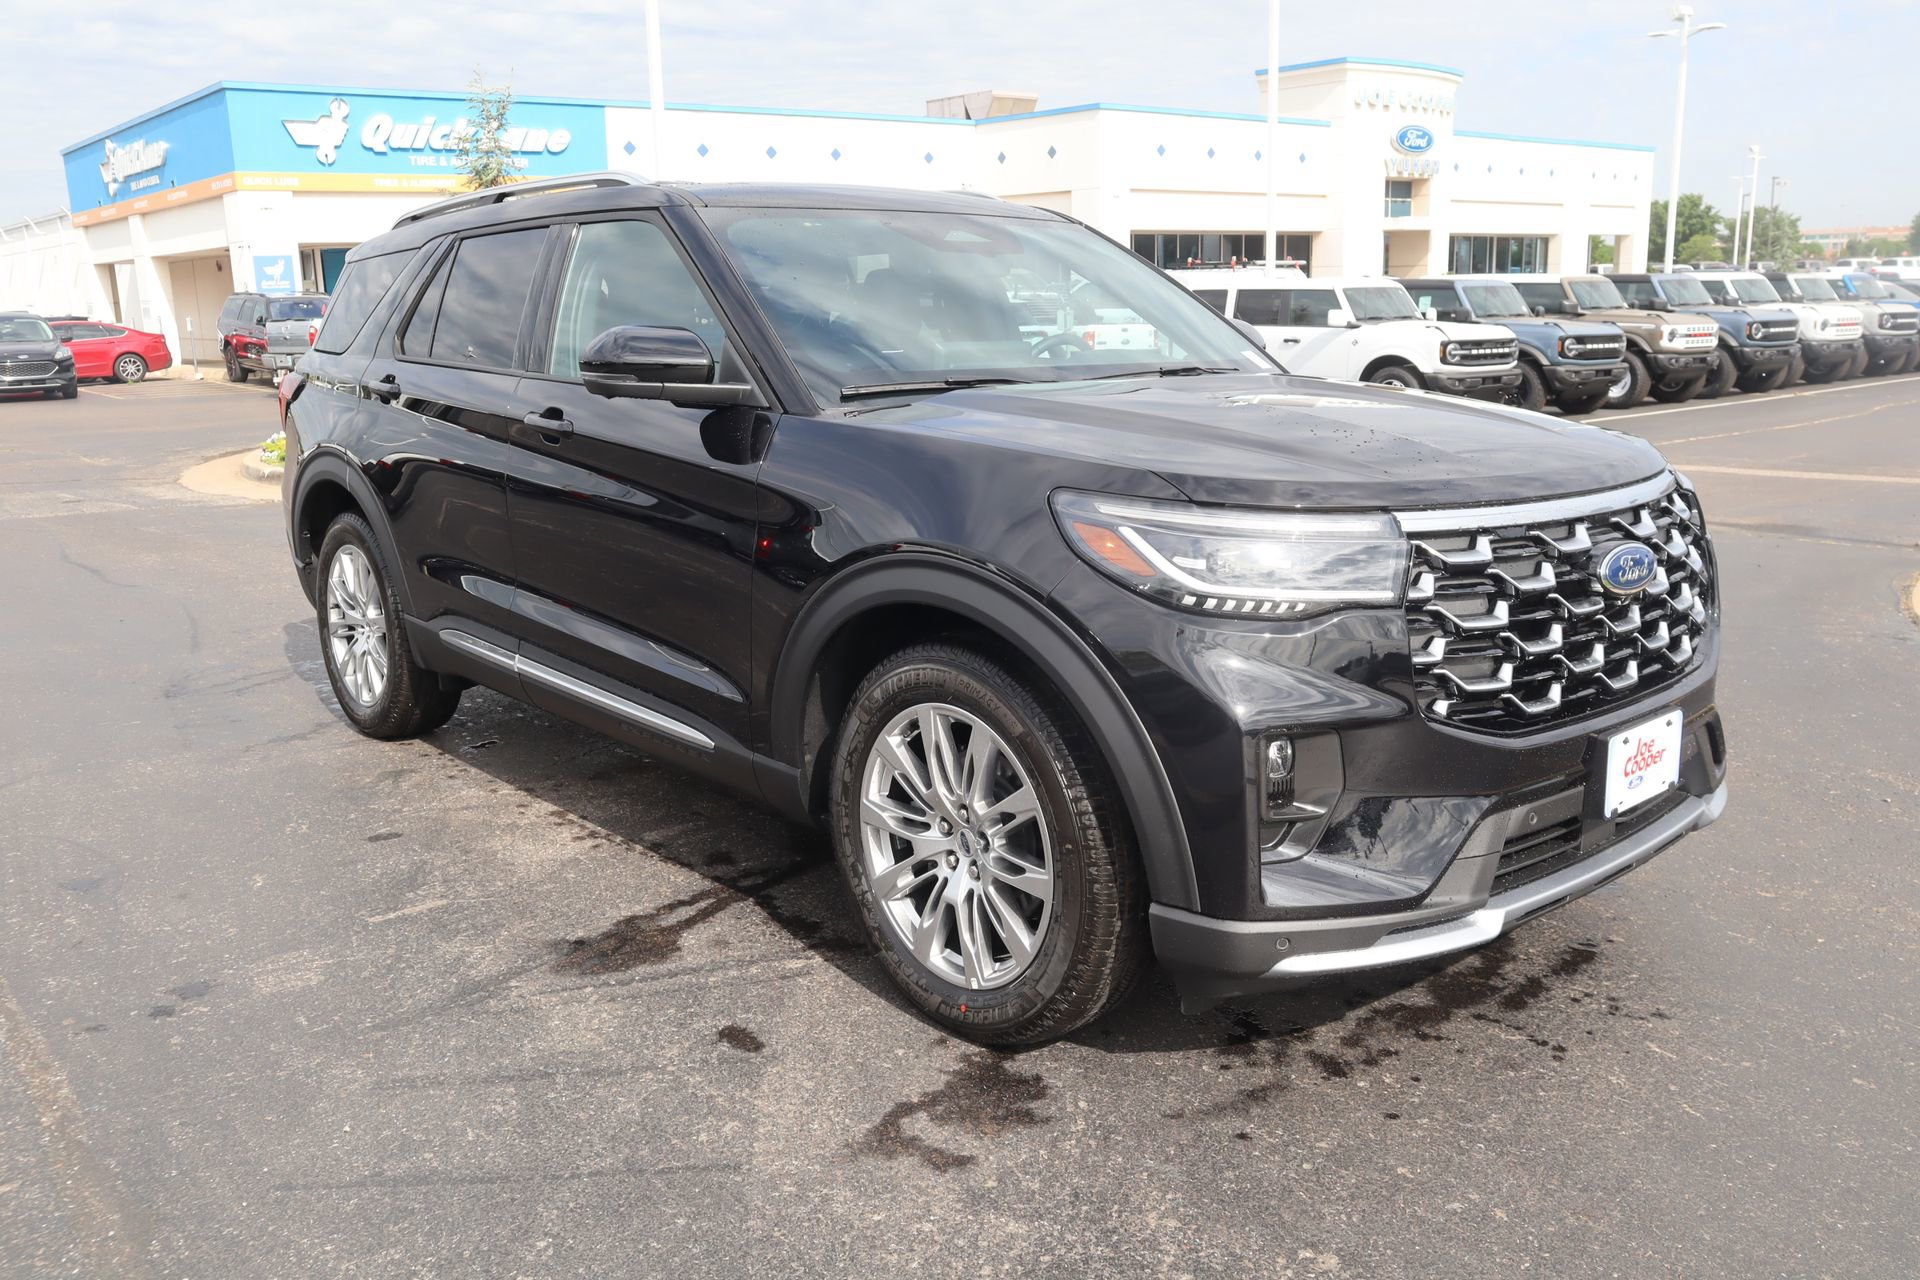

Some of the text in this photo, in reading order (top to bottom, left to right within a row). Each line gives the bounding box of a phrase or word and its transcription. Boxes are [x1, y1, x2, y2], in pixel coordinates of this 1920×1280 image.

[361, 114, 477, 153] Quick
[1404, 130, 1429, 147] Ford
[408, 155, 437, 166] TIRE
[439, 156, 448, 166] &
[1619, 554, 1650, 583] Ford
[1633, 737, 1655, 760] Joe
[1624, 748, 1666, 778] Cooper
